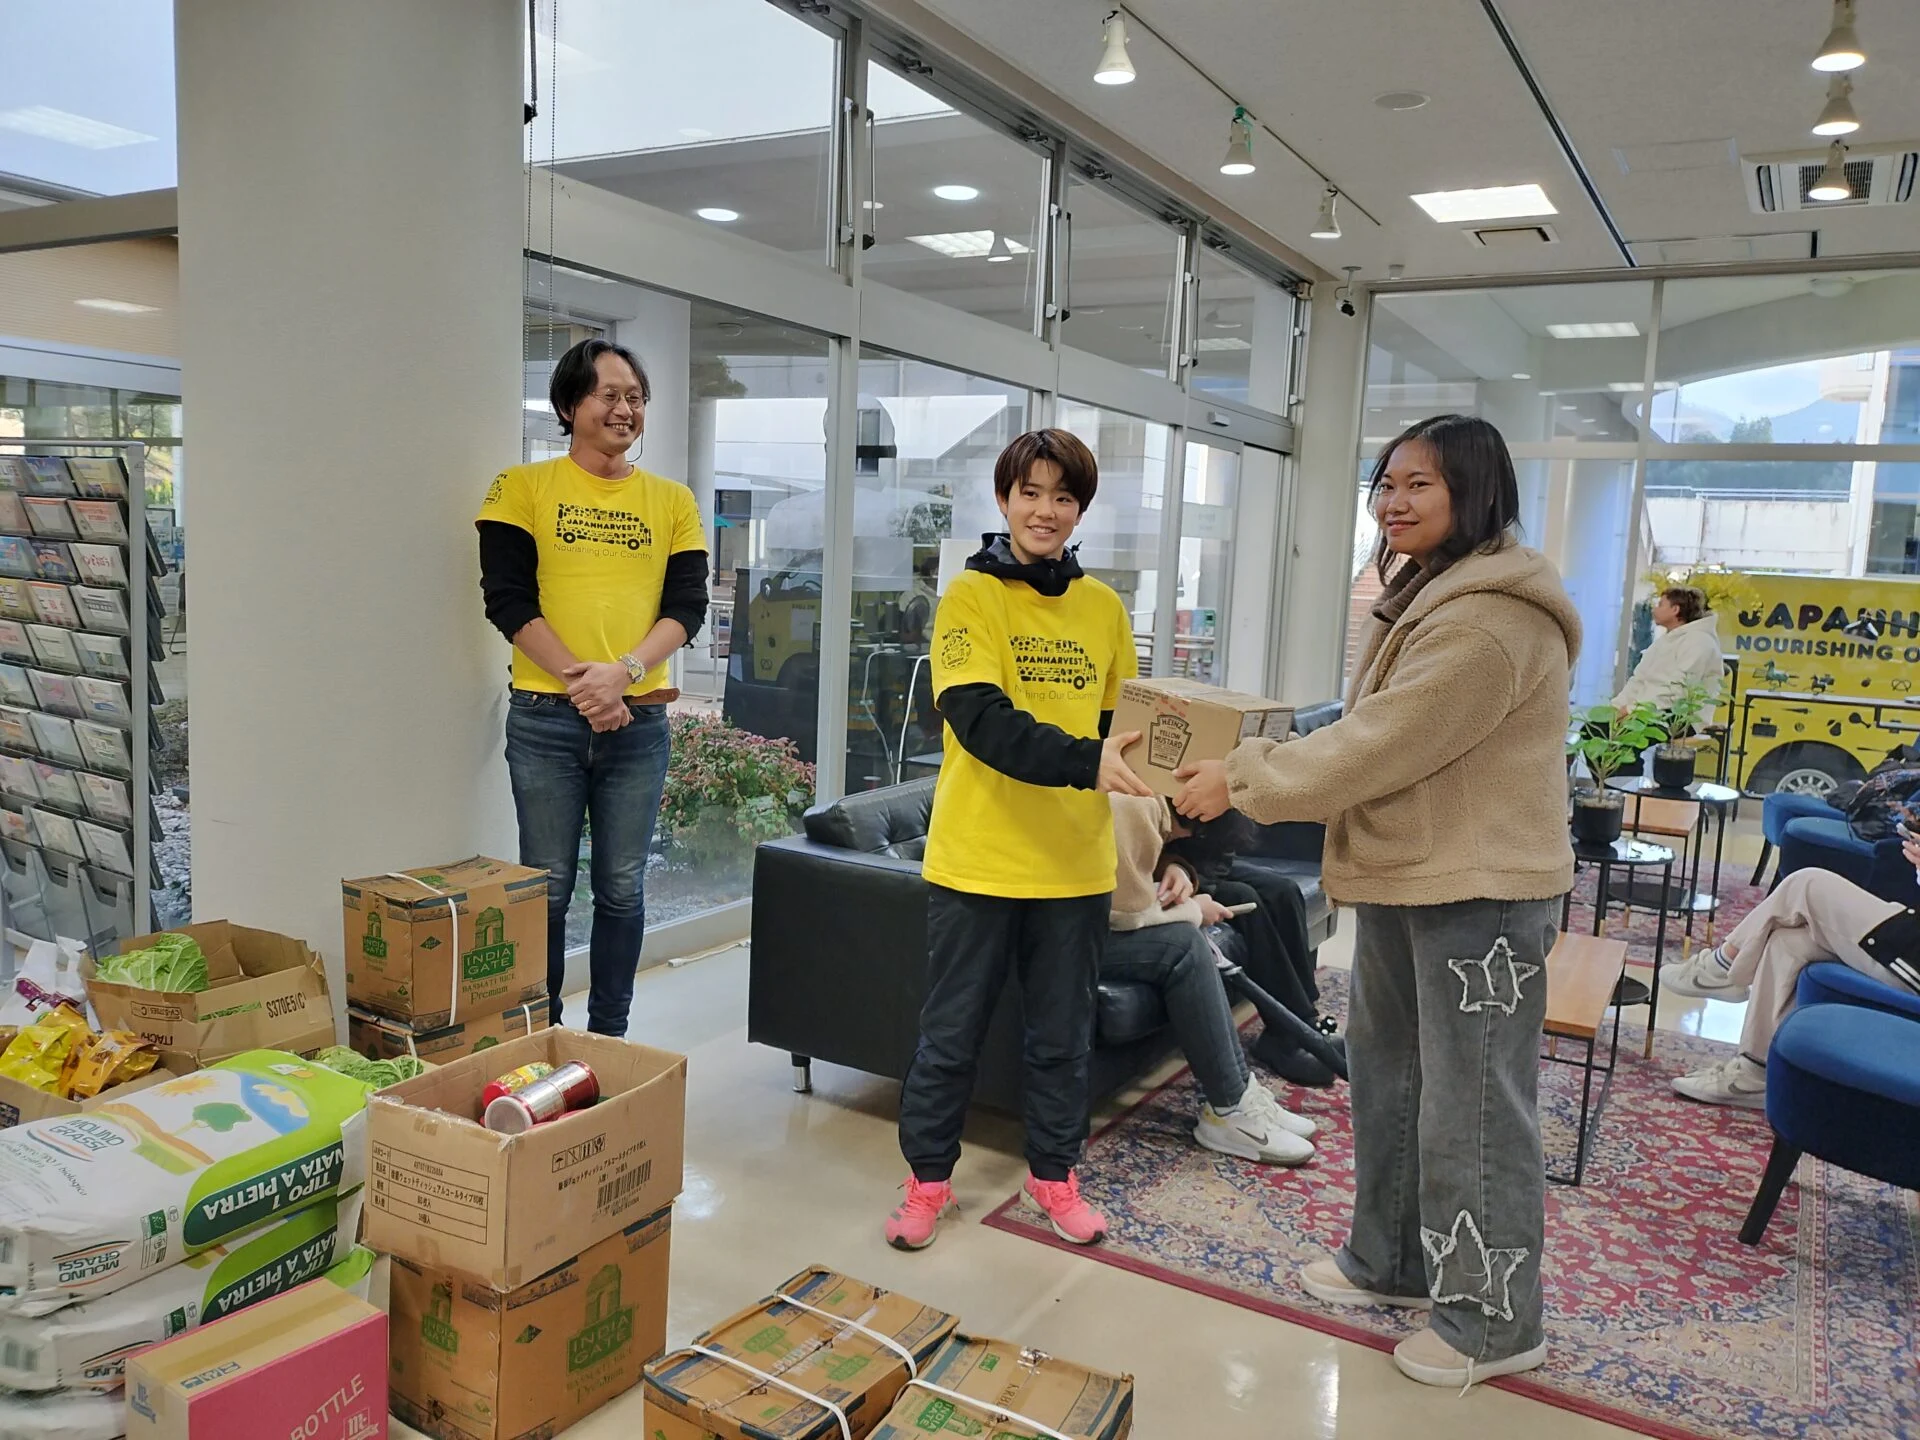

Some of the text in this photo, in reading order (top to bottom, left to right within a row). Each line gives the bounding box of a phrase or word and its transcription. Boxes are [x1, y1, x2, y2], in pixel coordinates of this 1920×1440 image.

[566, 519, 638, 531] JAPANHARVEST
[553, 543, 653, 561] Nourishing Our Country
[1736, 635, 1894, 661] NOURISHING
[1159, 729, 1182, 740] YELLOW
[1161, 718, 1184, 730] HEINZ
[1153, 735, 1183, 749] MUSTARD
[466, 947, 511, 966] INDIA
[467, 957, 510, 975] GATE
[470, 985, 508, 1005] Premium
[48, 1125, 109, 1152] GRASSI
[66, 1119, 125, 1146] MOLINO
[281, 1168, 296, 1188] A
[202, 1176, 278, 1221] PIETRA
[271, 1171, 331, 1210] TIPO 1
[58, 1250, 121, 1272] GRASSI
[58, 1259, 120, 1283] MOLINO
[285, 1254, 298, 1271] A
[217, 1267, 282, 1313] PIETRA
[573, 1315, 629, 1353] INDIA
[574, 1329, 626, 1364] GATE
[84, 1364, 125, 1379] OLINO
[290, 1373, 365, 1440] BOTTLE
[920, 1401, 943, 1427] GATE
[929, 1403, 953, 1430] INDIA
